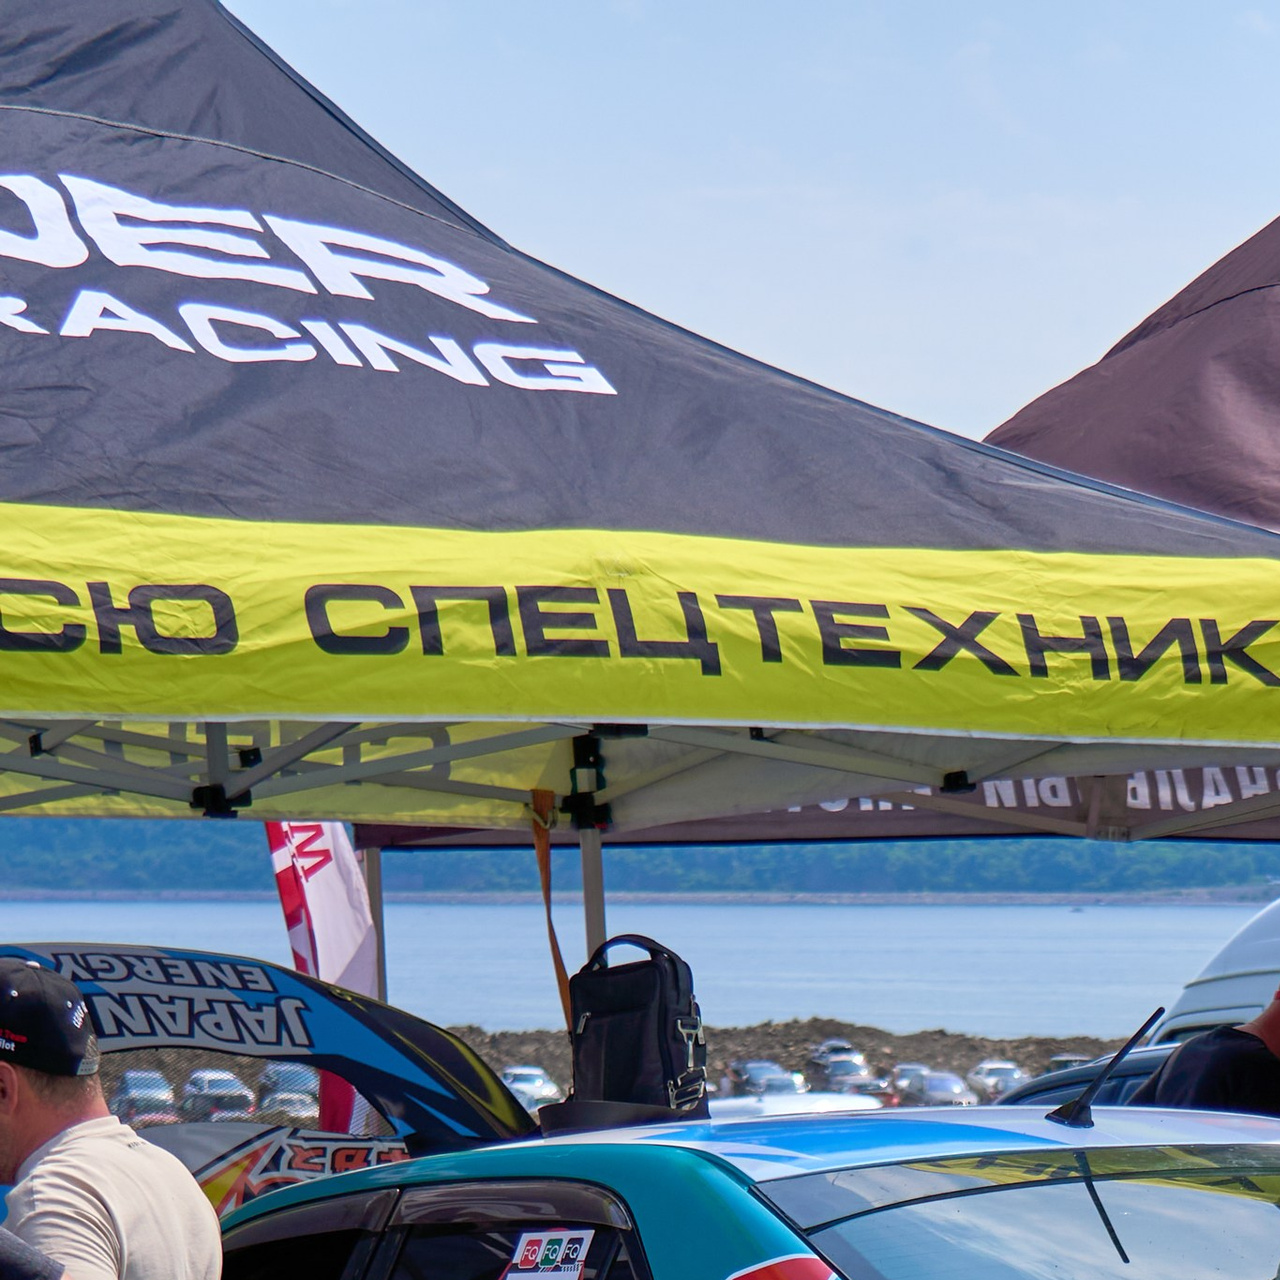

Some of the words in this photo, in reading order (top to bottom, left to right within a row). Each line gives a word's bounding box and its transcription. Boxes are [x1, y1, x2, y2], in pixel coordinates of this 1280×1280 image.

[53, 954, 276, 992] ENERGY
[92, 993, 312, 1047] JAPAN
[521, 1246, 539, 1264] FQ
[542, 1245, 560, 1263] FQ
[562, 1243, 580, 1262] FQ
